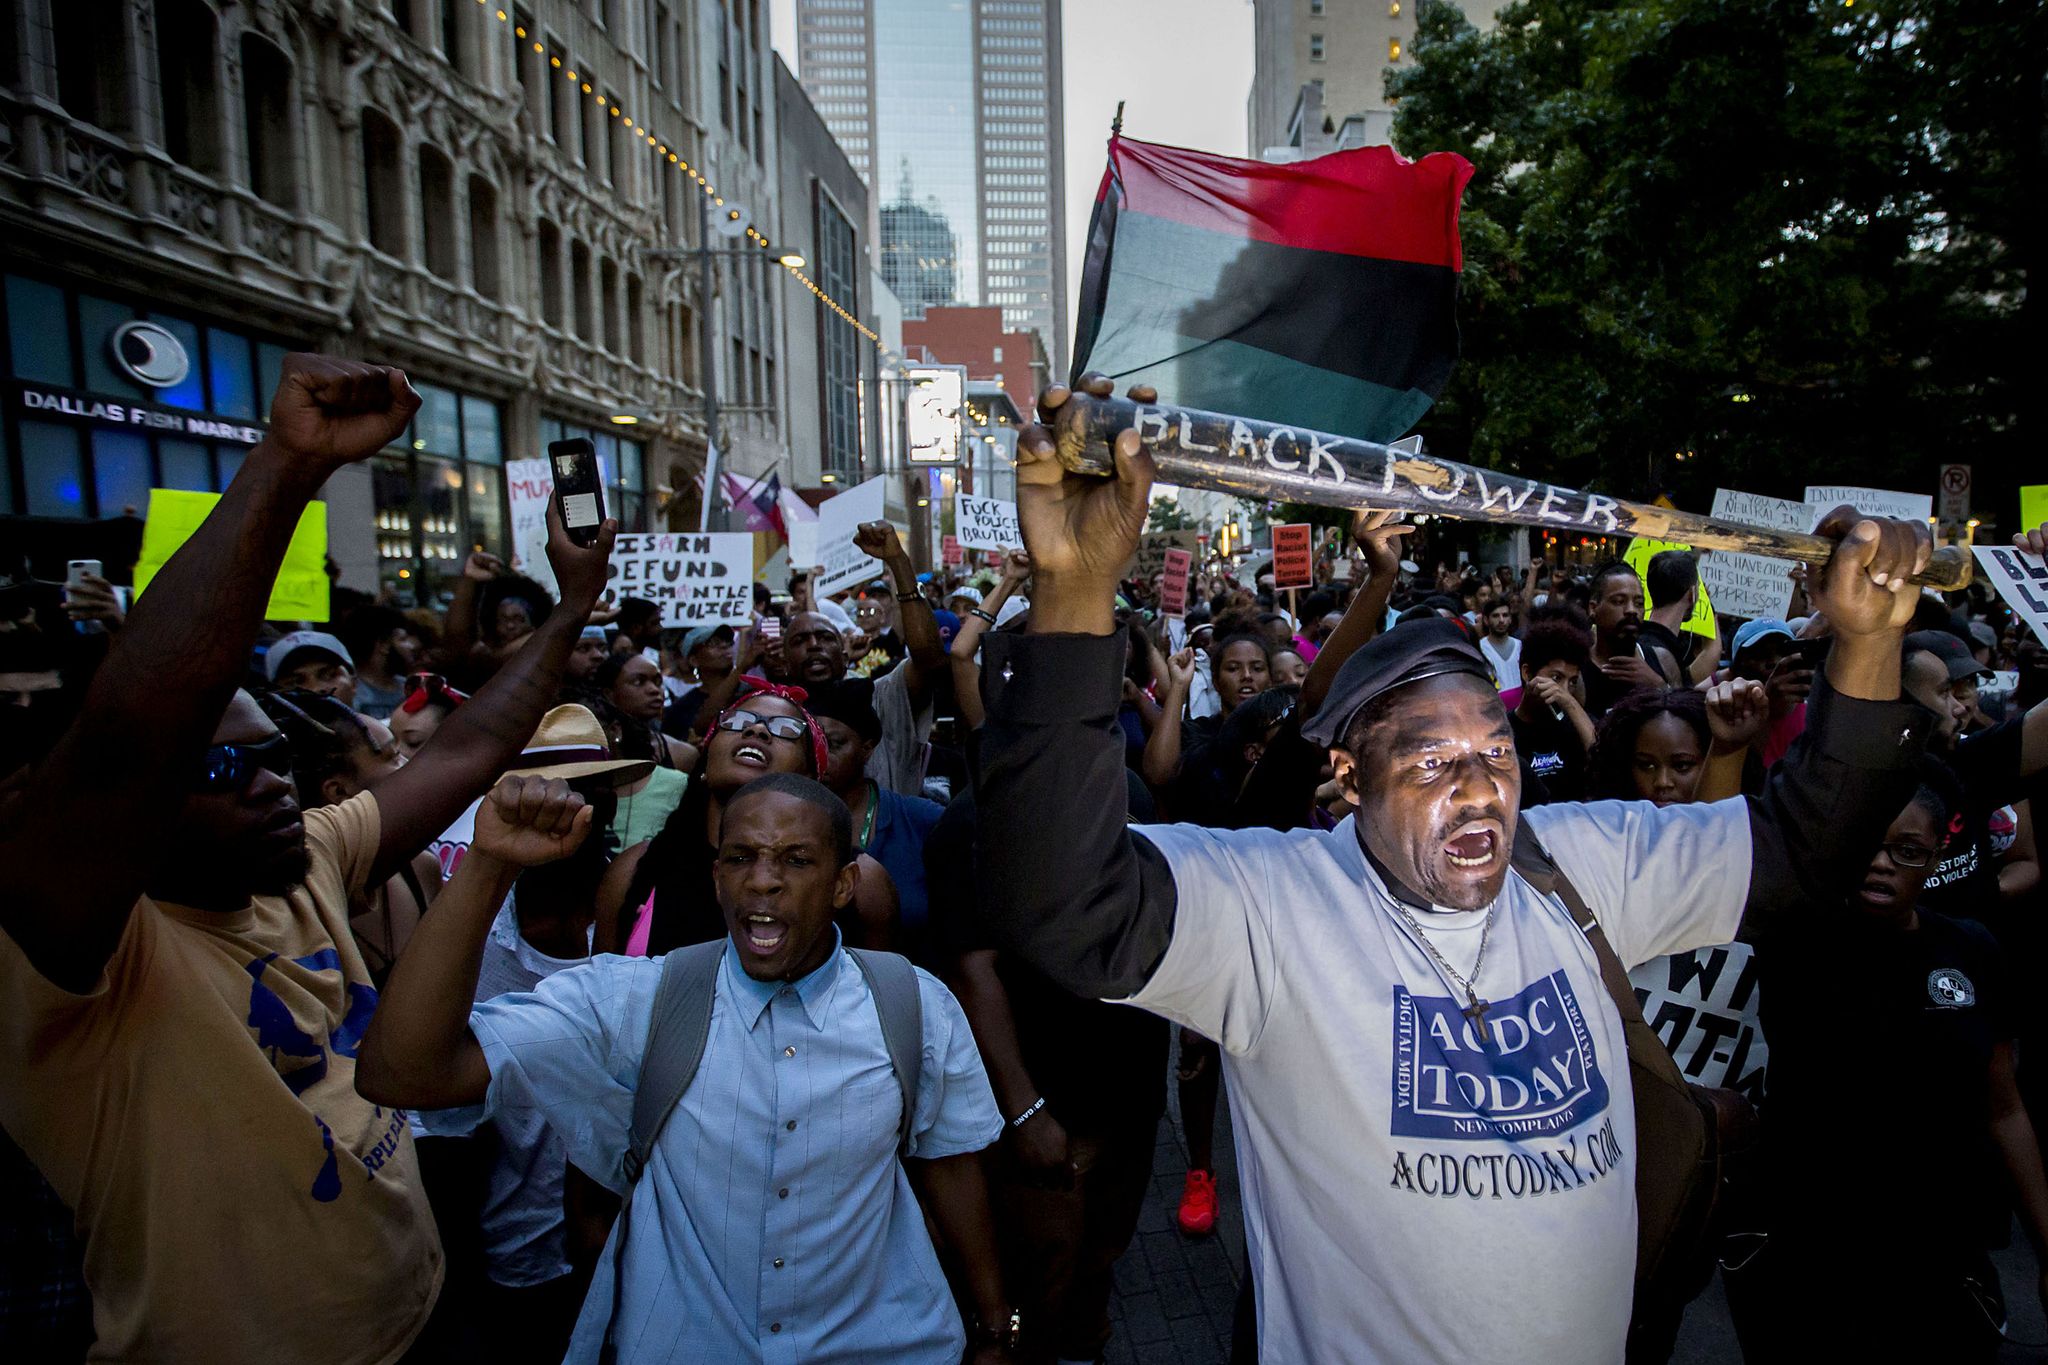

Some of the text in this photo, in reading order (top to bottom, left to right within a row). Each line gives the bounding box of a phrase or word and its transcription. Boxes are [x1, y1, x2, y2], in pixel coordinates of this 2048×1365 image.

[24, 390, 125, 422] DALLAS
[130, 407, 184, 431] FISH
[1135, 405, 1620, 532] BLACK POWER
[961, 498, 1001, 516] FUCK
[1746, 494, 1769, 506] YOU
[975, 515, 1018, 529] POLICE
[1725, 501, 1773, 521] NEUTRAL
[1783, 513, 1799, 527] IN
[616, 533, 711, 555] ISARM
[1280, 531, 1303, 540] Stop
[608, 559, 728, 582] DEFUND
[1277, 556, 1307, 565] Police
[1707, 550, 1730, 566] YOU
[1734, 554, 1762, 573] HAVE
[1278, 569, 1306, 577] Terror
[1702, 566, 1724, 581] THE
[1726, 571, 1755, 587] SIDE
[606, 583, 748, 605] DISMANTLE
[675, 601, 745, 620] POLICE
[1564, 993, 1594, 1071] PLATFORM
[1397, 993, 1412, 1109] DIGITAL MEDIA
[1422, 1047, 1576, 1112] TODAY
[1453, 1119, 1488, 1133] NEW
